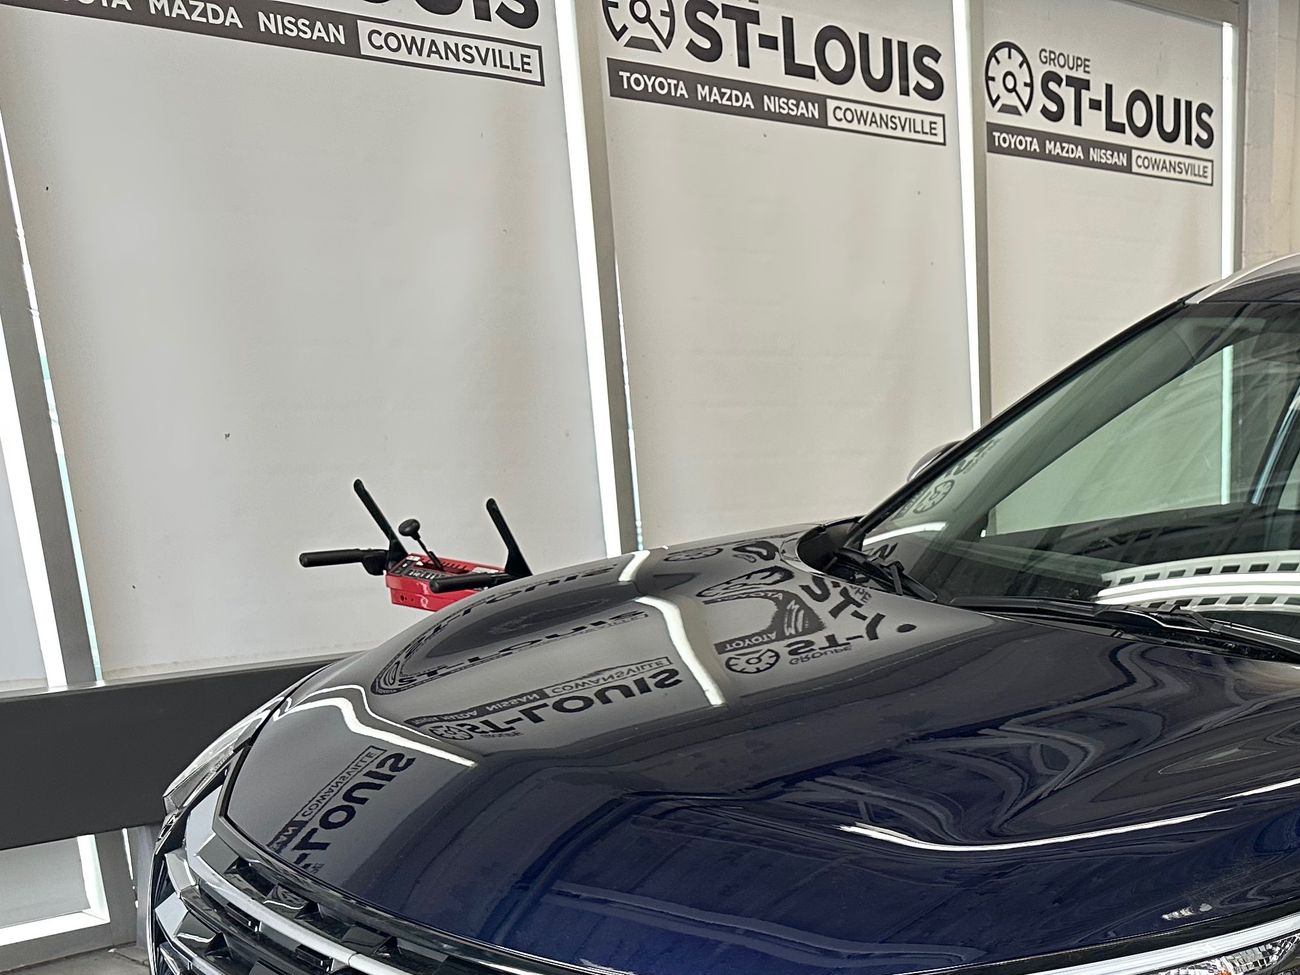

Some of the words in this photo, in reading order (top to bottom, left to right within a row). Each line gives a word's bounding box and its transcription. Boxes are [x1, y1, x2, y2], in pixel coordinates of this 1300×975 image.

[149, 0, 243, 29] MAZDA
[256, 11, 346, 45] NISSAN
[367, 28, 533, 74] COWANSVILLE
[684, 0, 945, 102] ST-LOUIS
[1038, 47, 1092, 75] GROUPE
[618, 71, 689, 99] TOYOTA
[696, 83, 755, 110] MAZDA
[763, 94, 820, 120] NISSAN
[832, 105, 939, 137] COWANSVILLE
[1039, 70, 1215, 150] ST-LOUIS
[992, 131, 1041, 153] TOYOTA
[1045, 140, 1084, 161] MAZDA
[1089, 147, 1128, 168] NISSAN
[1135, 154, 1209, 179] COWANSVILLE
